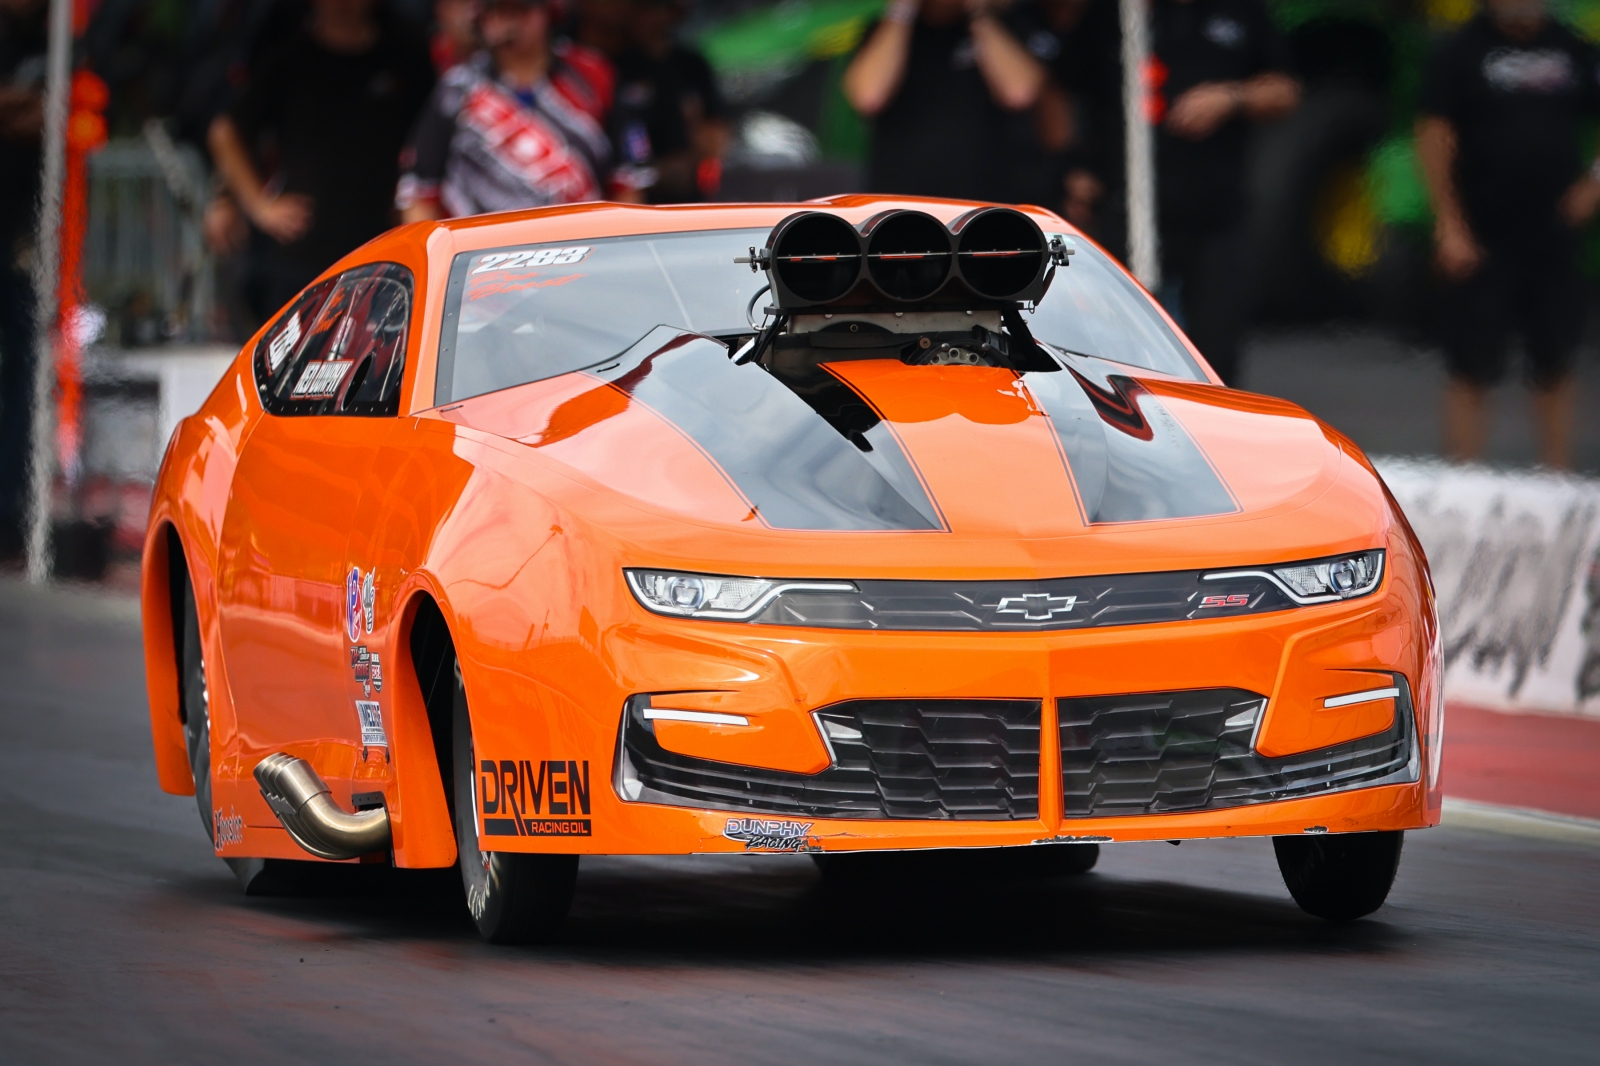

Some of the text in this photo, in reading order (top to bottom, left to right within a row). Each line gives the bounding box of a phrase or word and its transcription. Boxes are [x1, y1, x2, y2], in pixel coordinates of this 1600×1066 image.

[471, 246, 592, 275] 2283
[306, 360, 355, 396] DUNPHY
[1198, 594, 1250, 608] SS
[481, 760, 591, 836] DRIVEN
[725, 818, 815, 837] DUNPHY
[745, 835, 805, 852] RACING
